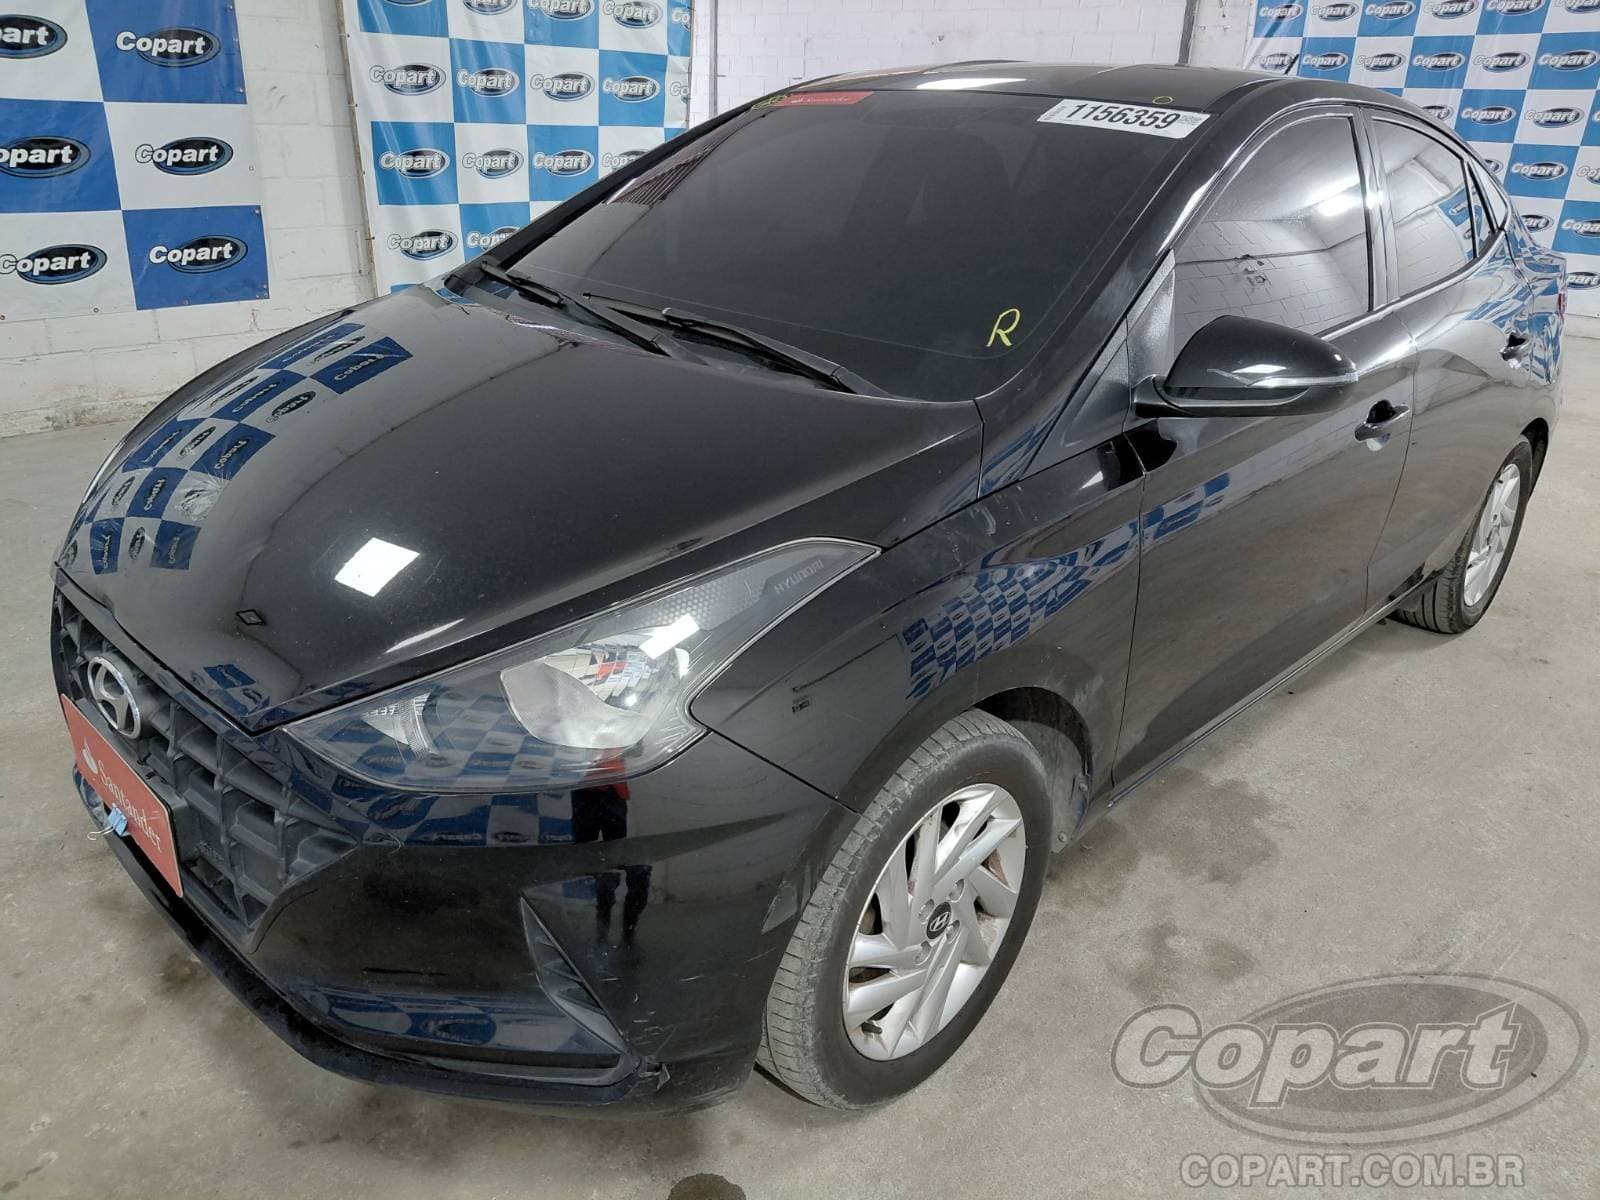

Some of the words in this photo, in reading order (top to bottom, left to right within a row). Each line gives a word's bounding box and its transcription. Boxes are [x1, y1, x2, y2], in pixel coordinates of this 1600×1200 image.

[602, 0, 656, 21] Copart
[1259, 5, 1298, 18] Copart
[1312, 5, 1351, 18] Copart
[1366, 3, 1408, 16] Copart
[1423, 0, 1471, 14] Copart
[1487, 0, 1537, 12] Copart
[0, 26, 49, 45] art
[115, 31, 205, 56] Copart
[1253, 53, 1290, 67] Copart
[1302, 54, 1344, 67] Copart
[1356, 54, 1401, 68] Copart
[1413, 54, 1459, 68] Copart
[1473, 53, 1524, 69] Copart
[1539, 52, 1593, 69] Copart
[369, 65, 437, 87] Copart
[456, 68, 513, 91] Copart
[530, 73, 588, 94] Copart
[603, 77, 653, 98] Copart
[1066, 103, 1182, 129] 1156359
[1461, 108, 1511, 122] Copart
[1525, 109, 1577, 124] Copart
[0, 145, 73, 168] opart
[135, 144, 219, 166] Copart
[380, 151, 443, 174] Copart
[462, 152, 516, 172] Copart
[534, 152, 588, 173] Copart
[1512, 163, 1561, 177] Copart
[1561, 219, 1600, 233] Copa
[149, 242, 234, 266] Copart
[387, 233, 450, 255] Copart
[0, 252, 91, 276] Copart
[1567, 274, 1600, 286] part
[987, 309, 1020, 347] R
[774, 559, 825, 595] HYUNDAI
[98, 759, 162, 852] Santander
